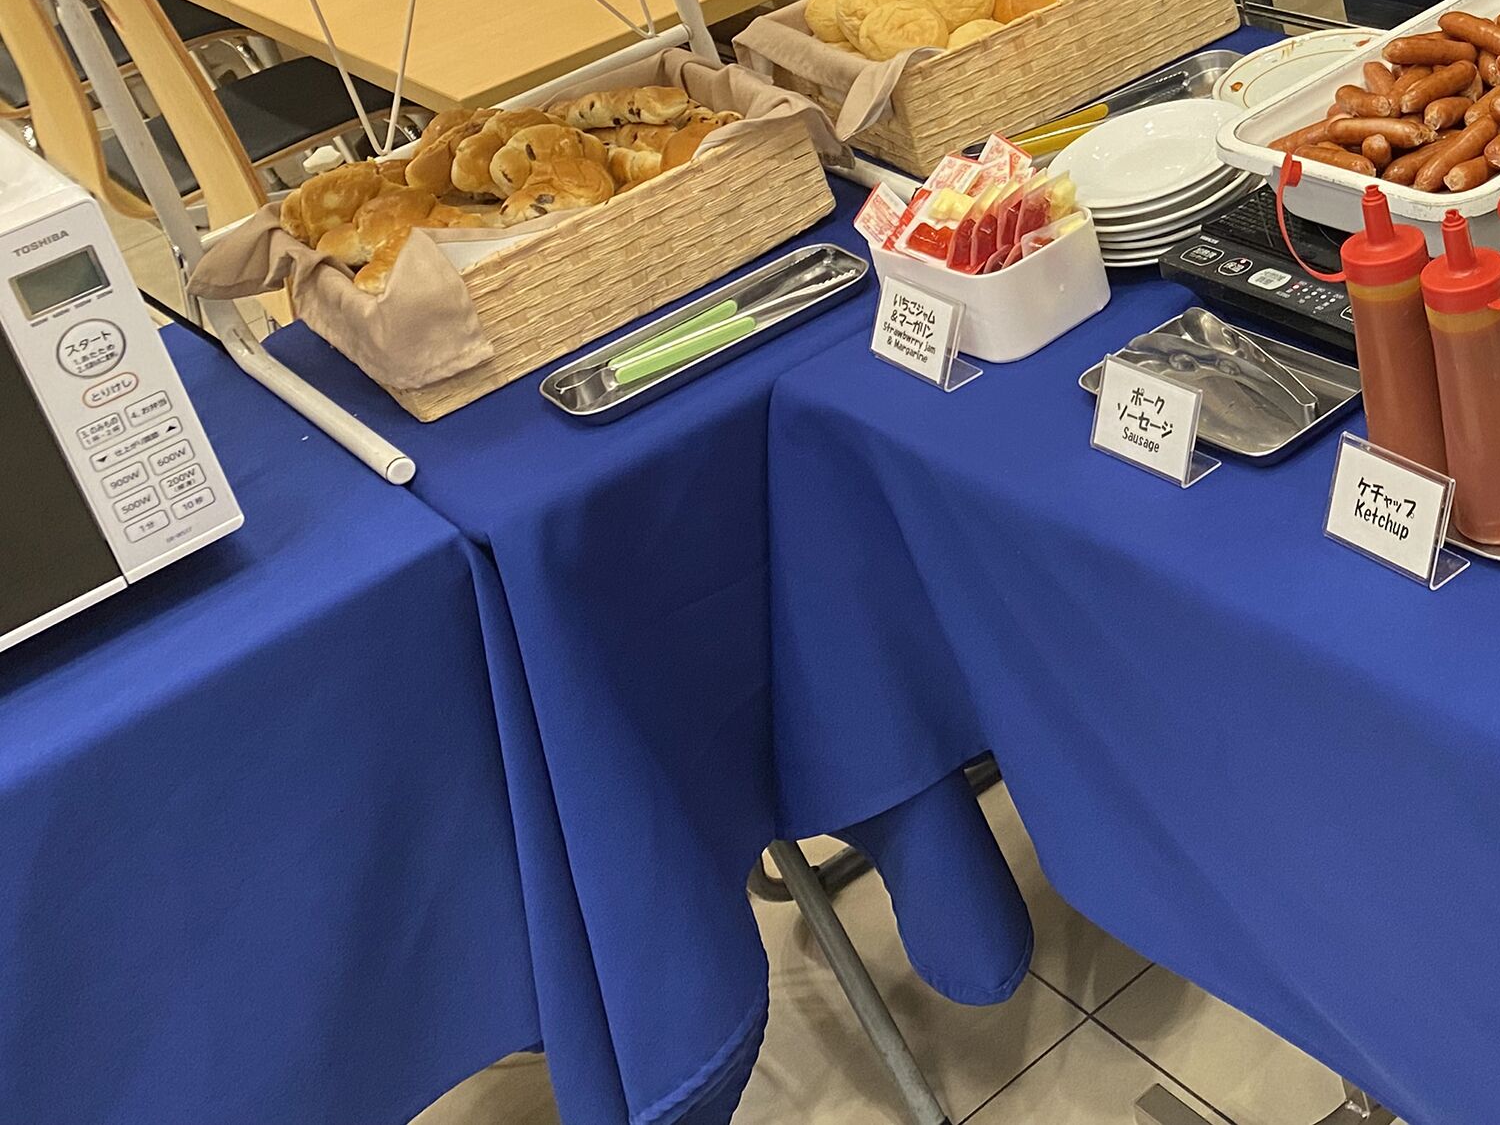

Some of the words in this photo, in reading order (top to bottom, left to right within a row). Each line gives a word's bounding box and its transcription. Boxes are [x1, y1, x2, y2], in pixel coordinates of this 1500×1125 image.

[11, 230, 70, 257] TOSHIBA
[893, 293, 936, 325] いちごジャム
[890, 309, 934, 339] &マーガリン
[65, 331, 111, 357] スタート
[893, 339, 928, 364] Margarine
[92, 380, 133, 402] とりけし
[1130, 387, 1165, 415] ポーク
[1117, 402, 1173, 438] ソーセージ
[1122, 426, 1160, 453] Sausage
[157, 446, 187, 467] 600W
[110, 468, 141, 489] 900W
[166, 468, 196, 488] 200W
[121, 494, 151, 515] 500W
[1357, 476, 1416, 519] ケチャップ
[1354, 498, 1409, 540] Ketchup
